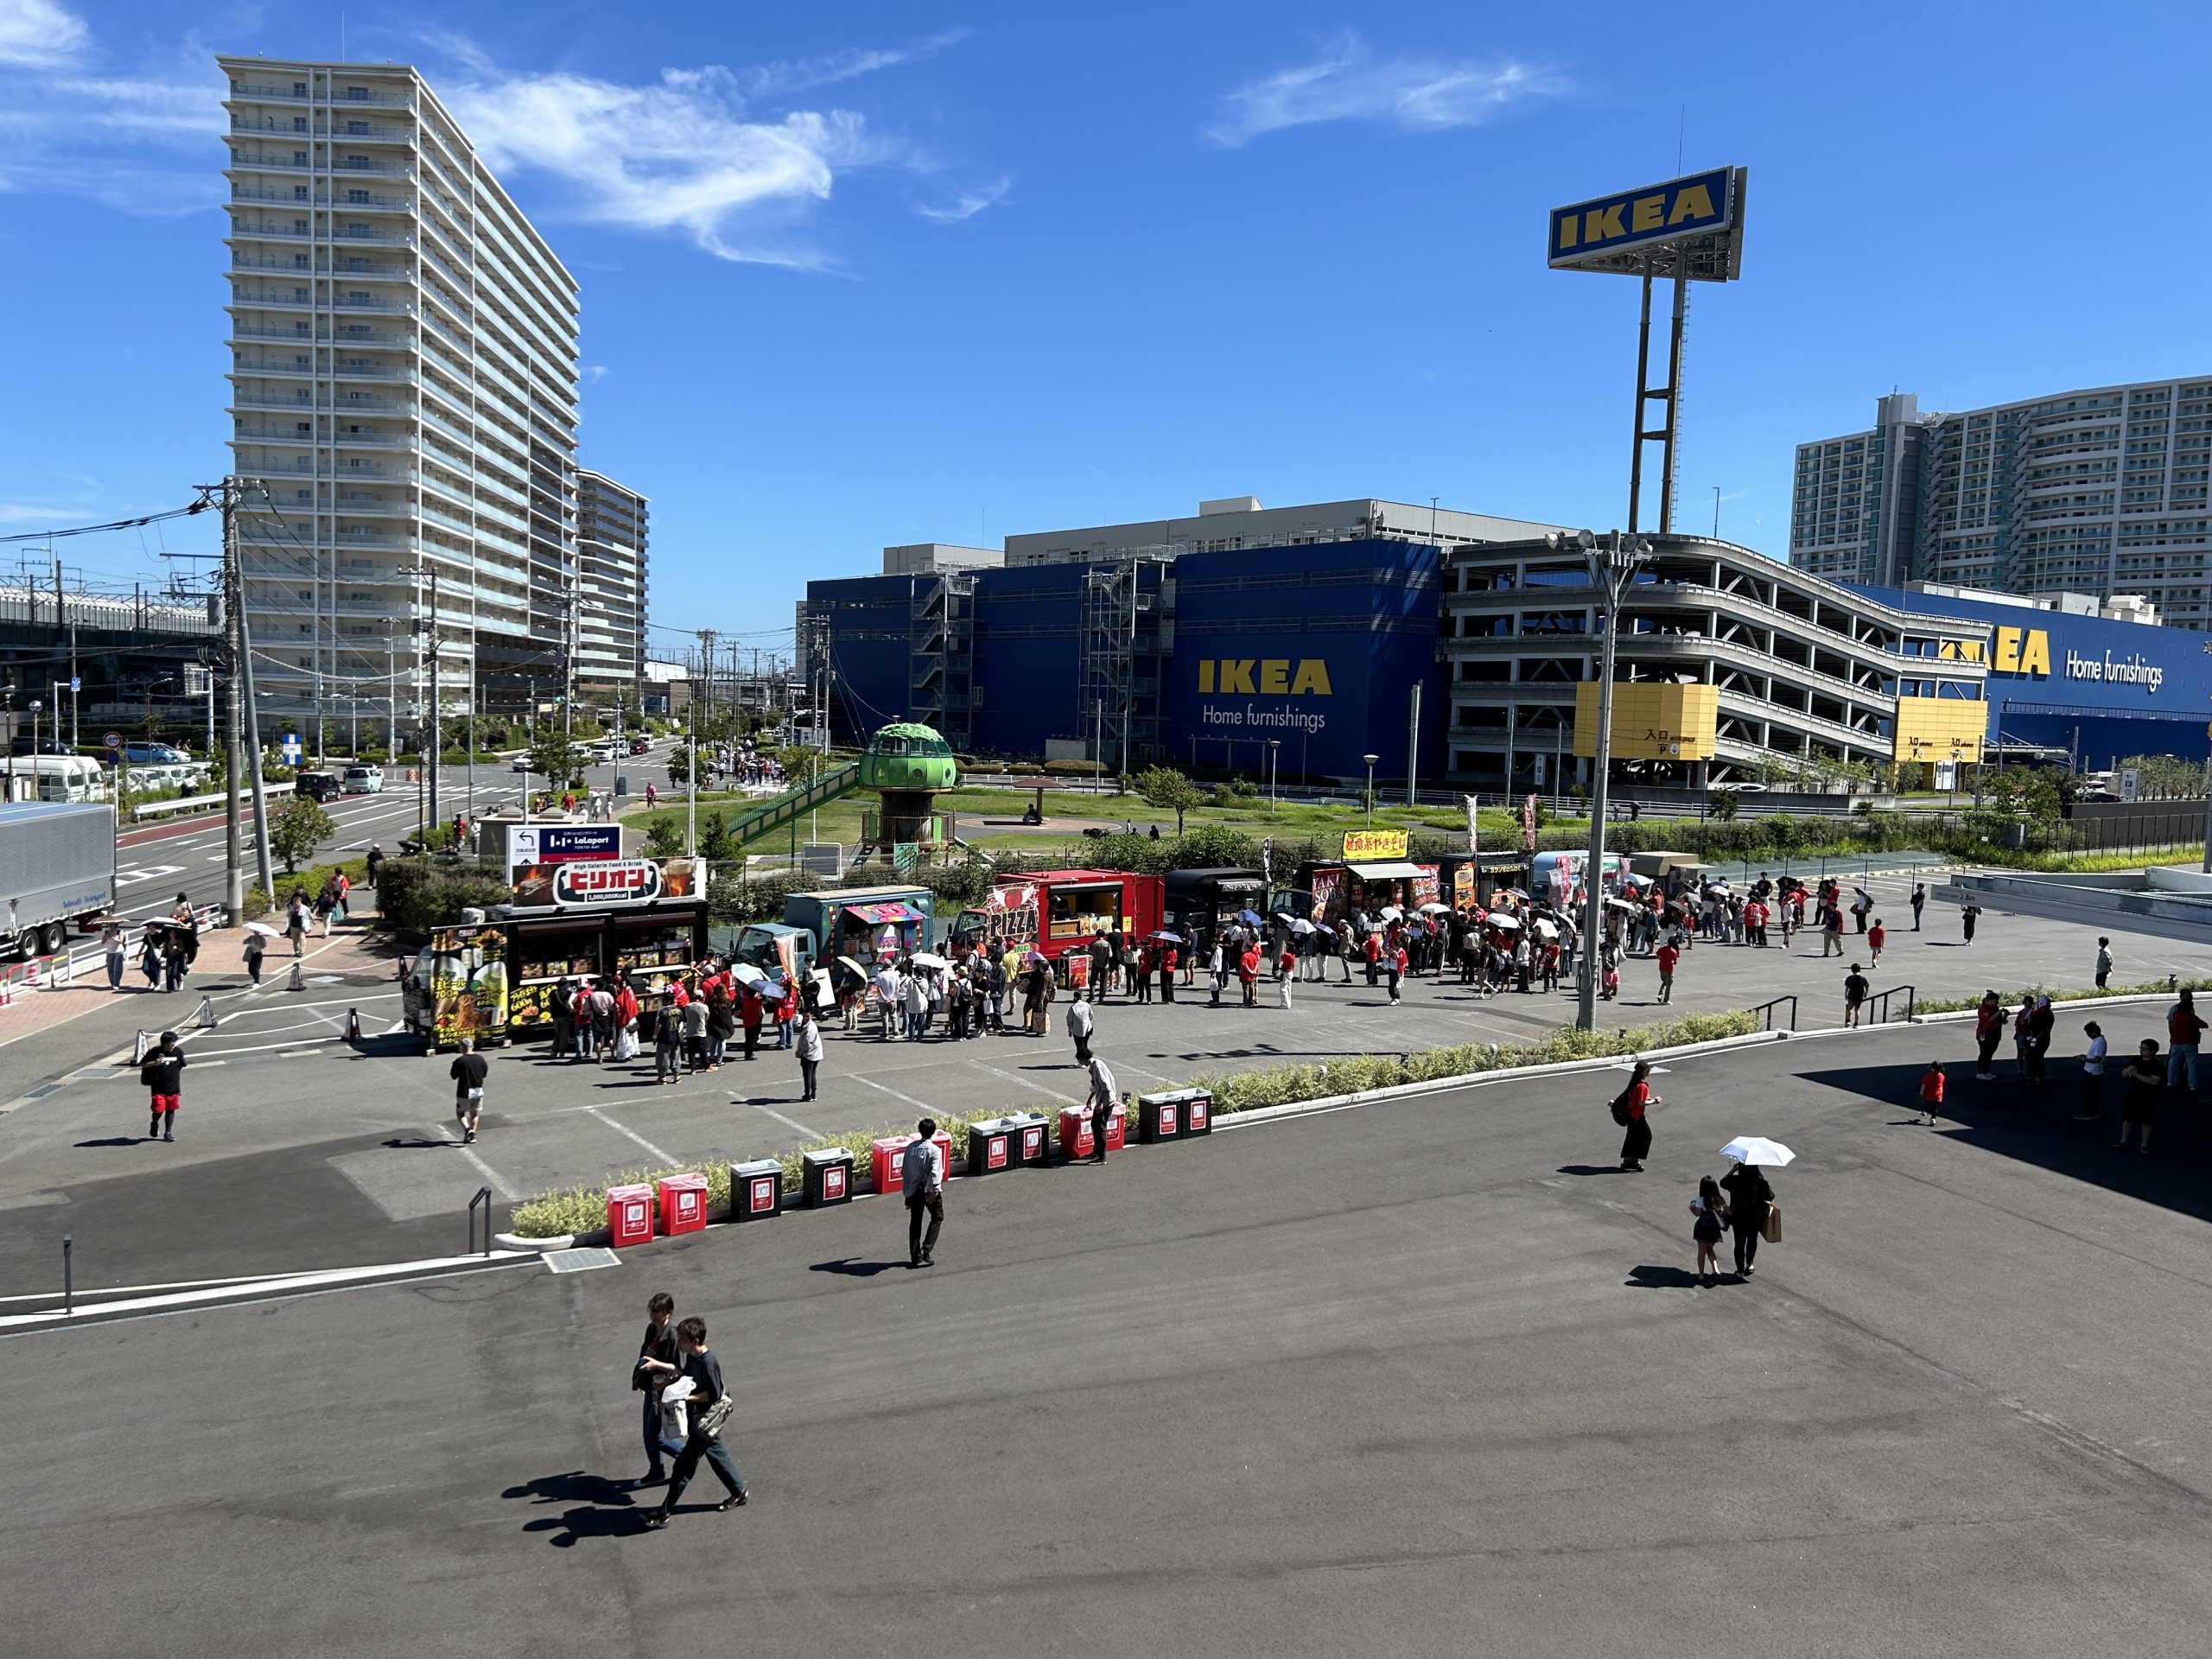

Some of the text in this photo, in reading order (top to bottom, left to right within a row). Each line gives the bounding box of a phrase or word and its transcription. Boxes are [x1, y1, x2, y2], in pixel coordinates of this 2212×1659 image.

[1560, 184, 1715, 249] IKEA
[1198, 659, 1332, 695] IKEA
[2066, 650, 2162, 692] Home furnishings
[1204, 703, 1325, 734] Home furnishings
[1645, 729, 1668, 741] 入口
[575, 836, 609, 845] LaLaport
[570, 868, 645, 891] ビリオン
[1312, 873, 1340, 891] YAKI
[1314, 887, 1348, 904] SOBA
[990, 910, 1037, 938] PIZZA
